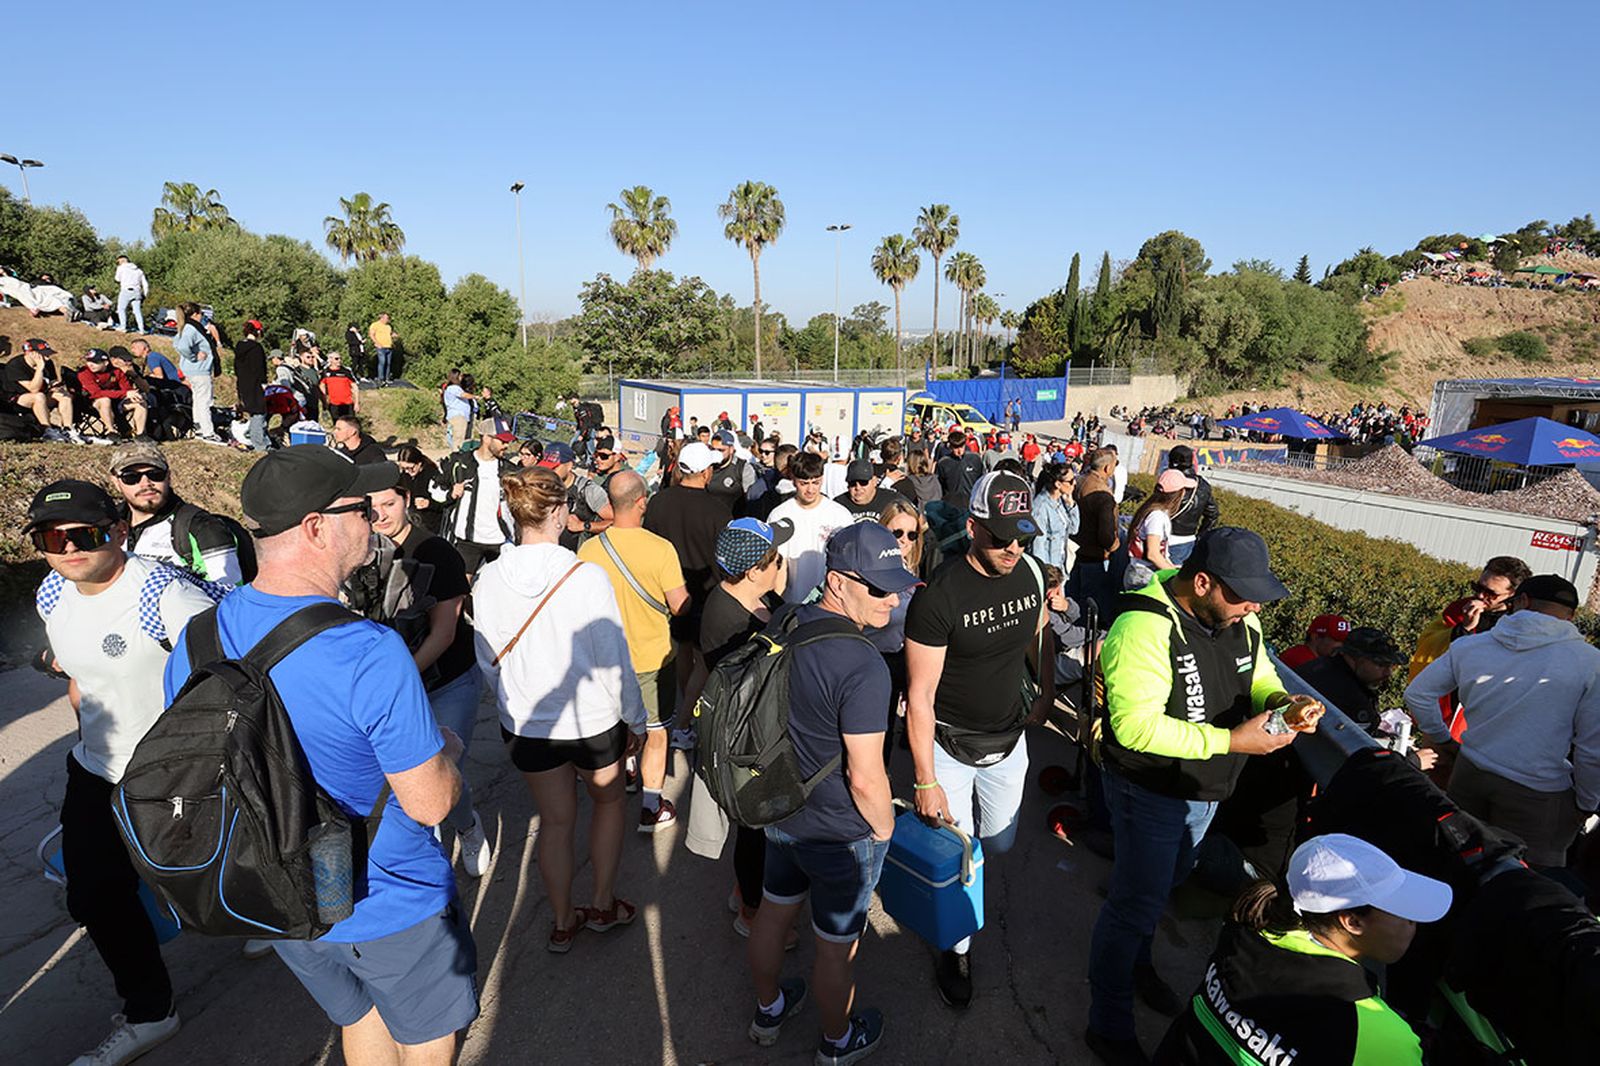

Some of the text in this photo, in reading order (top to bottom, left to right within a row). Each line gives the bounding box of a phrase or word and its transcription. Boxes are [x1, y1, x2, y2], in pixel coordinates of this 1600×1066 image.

[963, 594, 1037, 628] PEPE JEANS
[1176, 653, 1206, 726] wasaki
[1205, 962, 1298, 1066] Kawasaki
